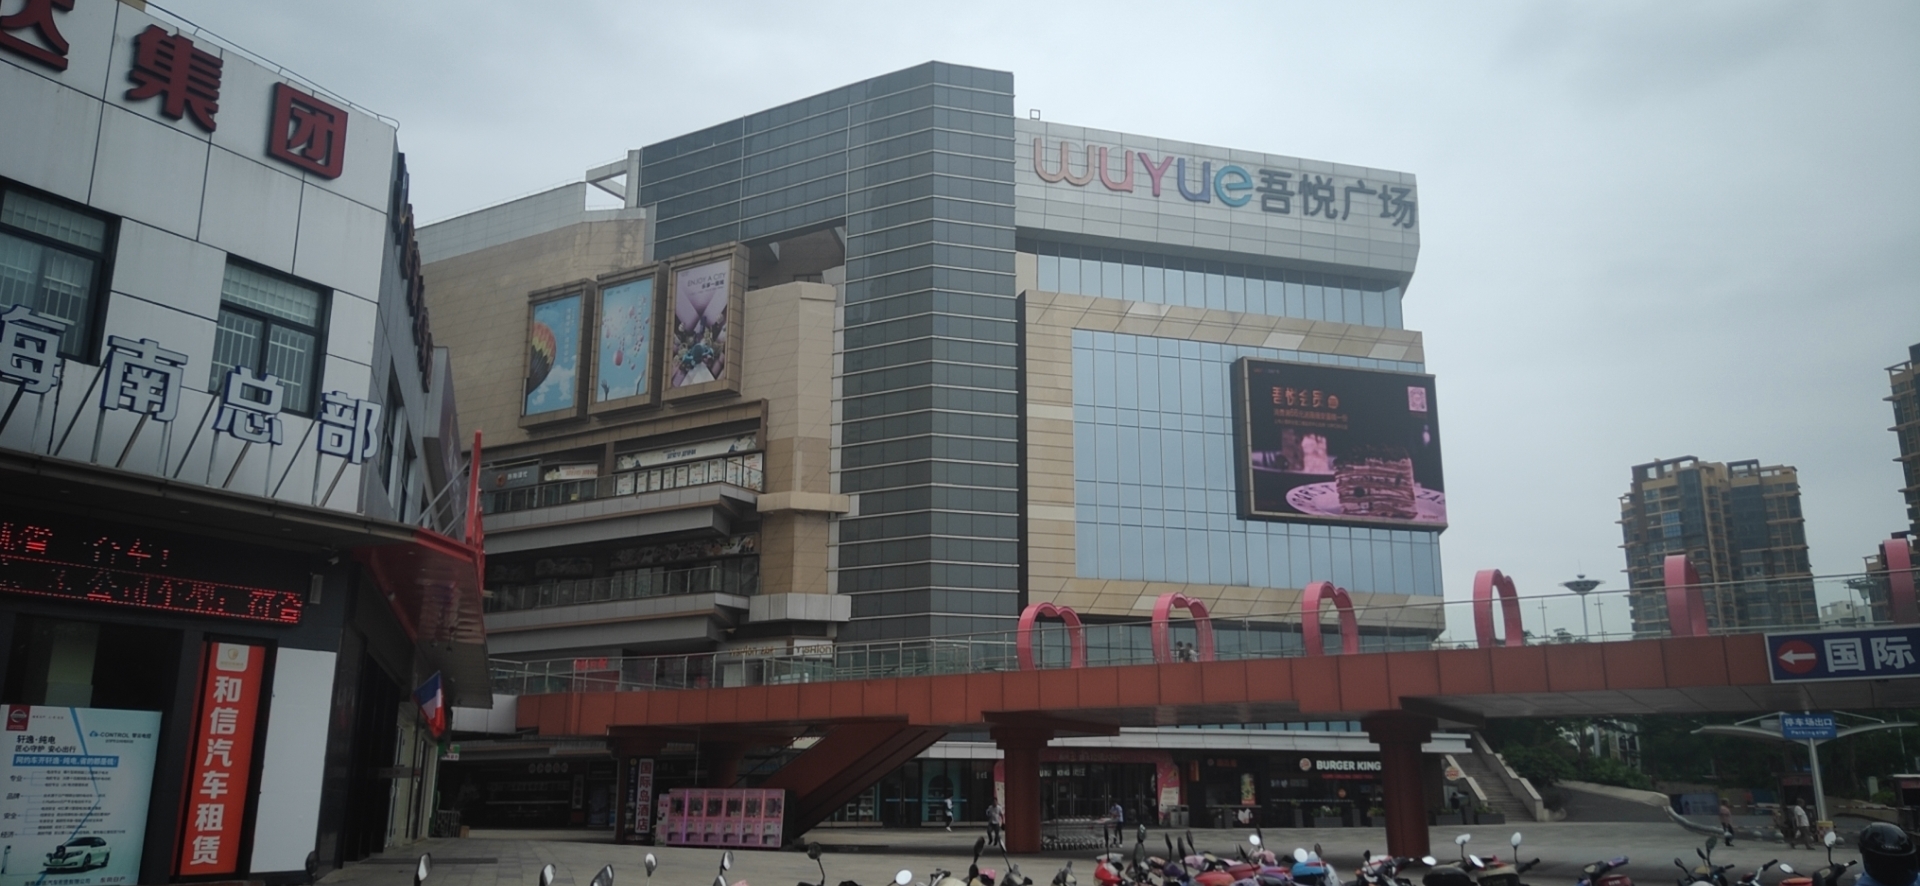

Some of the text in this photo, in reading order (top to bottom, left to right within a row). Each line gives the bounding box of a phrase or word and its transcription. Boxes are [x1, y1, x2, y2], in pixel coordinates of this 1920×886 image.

[1255, 167, 1416, 229] 吾悦广场
[0, 303, 383, 465] 海南总部
[1823, 636, 1916, 673] 国际
[1784, 717, 1833, 727] 停车场出口
[48, 745, 77, 753] 安心出行
[1316, 760, 1382, 771] BURGER KING
[190, 675, 243, 866] 和信汽车租赁
[636, 761, 652, 831] 国际岛酒店
[3, 812, 17, 820] 安全
